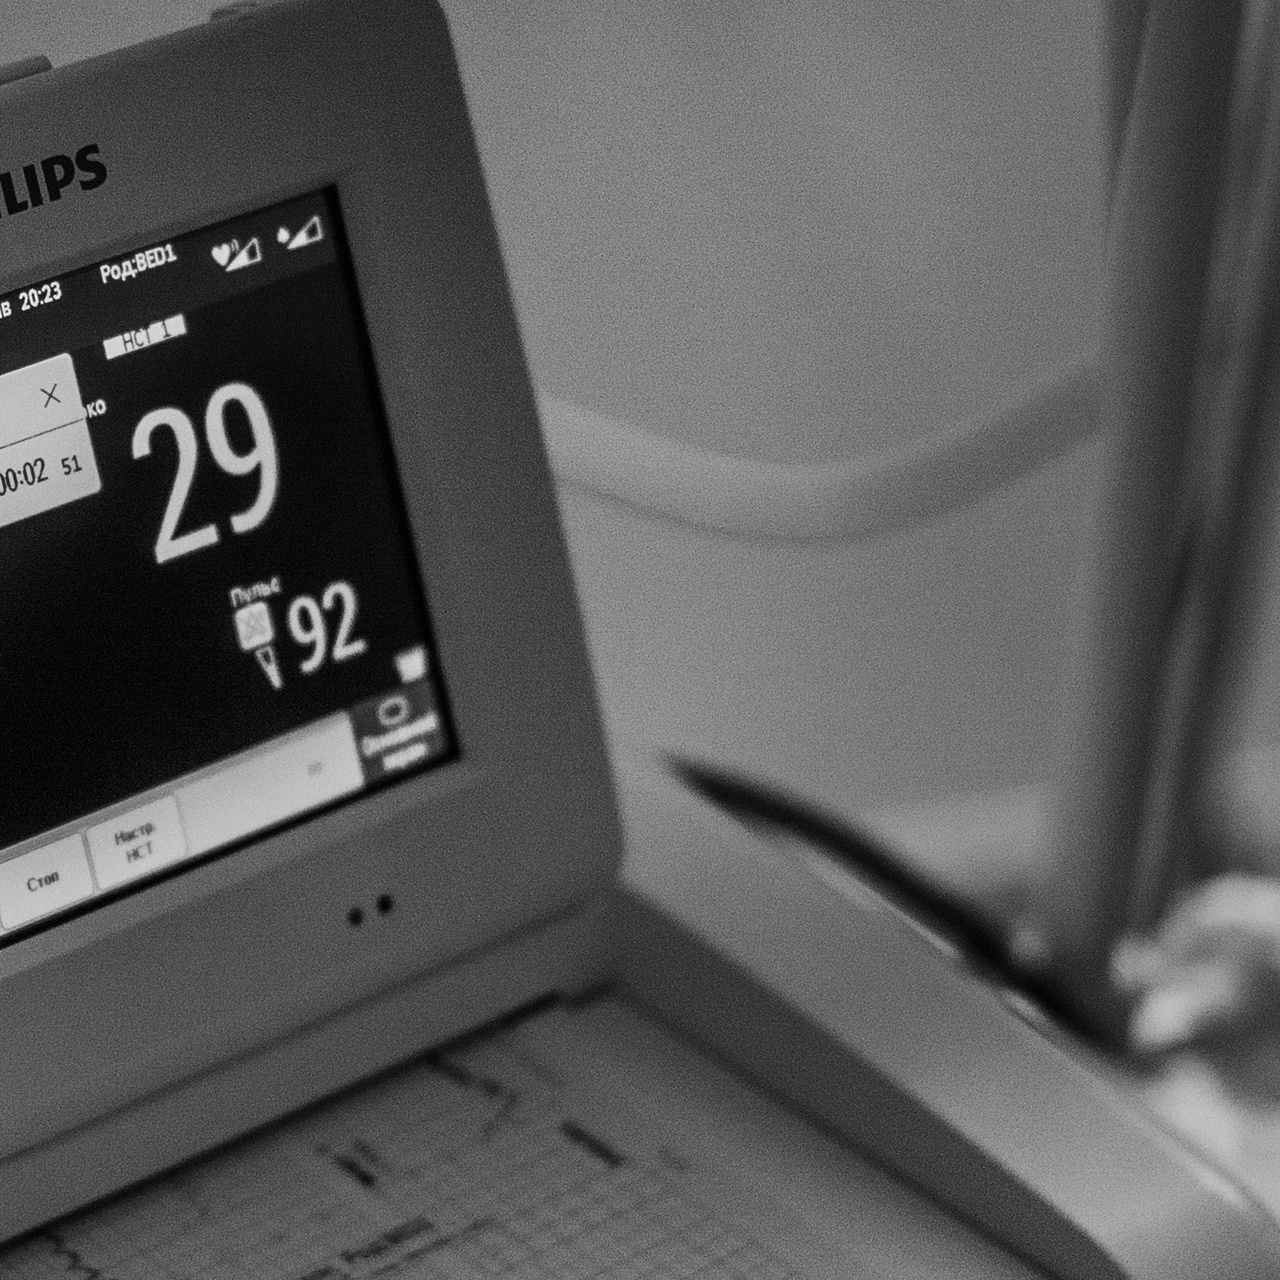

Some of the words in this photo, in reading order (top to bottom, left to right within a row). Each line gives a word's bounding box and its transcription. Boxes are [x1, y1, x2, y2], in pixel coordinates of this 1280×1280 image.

[100, 244, 177, 283] Род:BED1
[19, 281, 63, 312] 20:23
[85, 398, 106, 420] ко
[61, 454, 83, 477] 51
[132, 381, 280, 565] 29
[287, 580, 368, 674] 92
[125, 841, 154, 865] НСТ
[26, 868, 60, 894] Стоп
